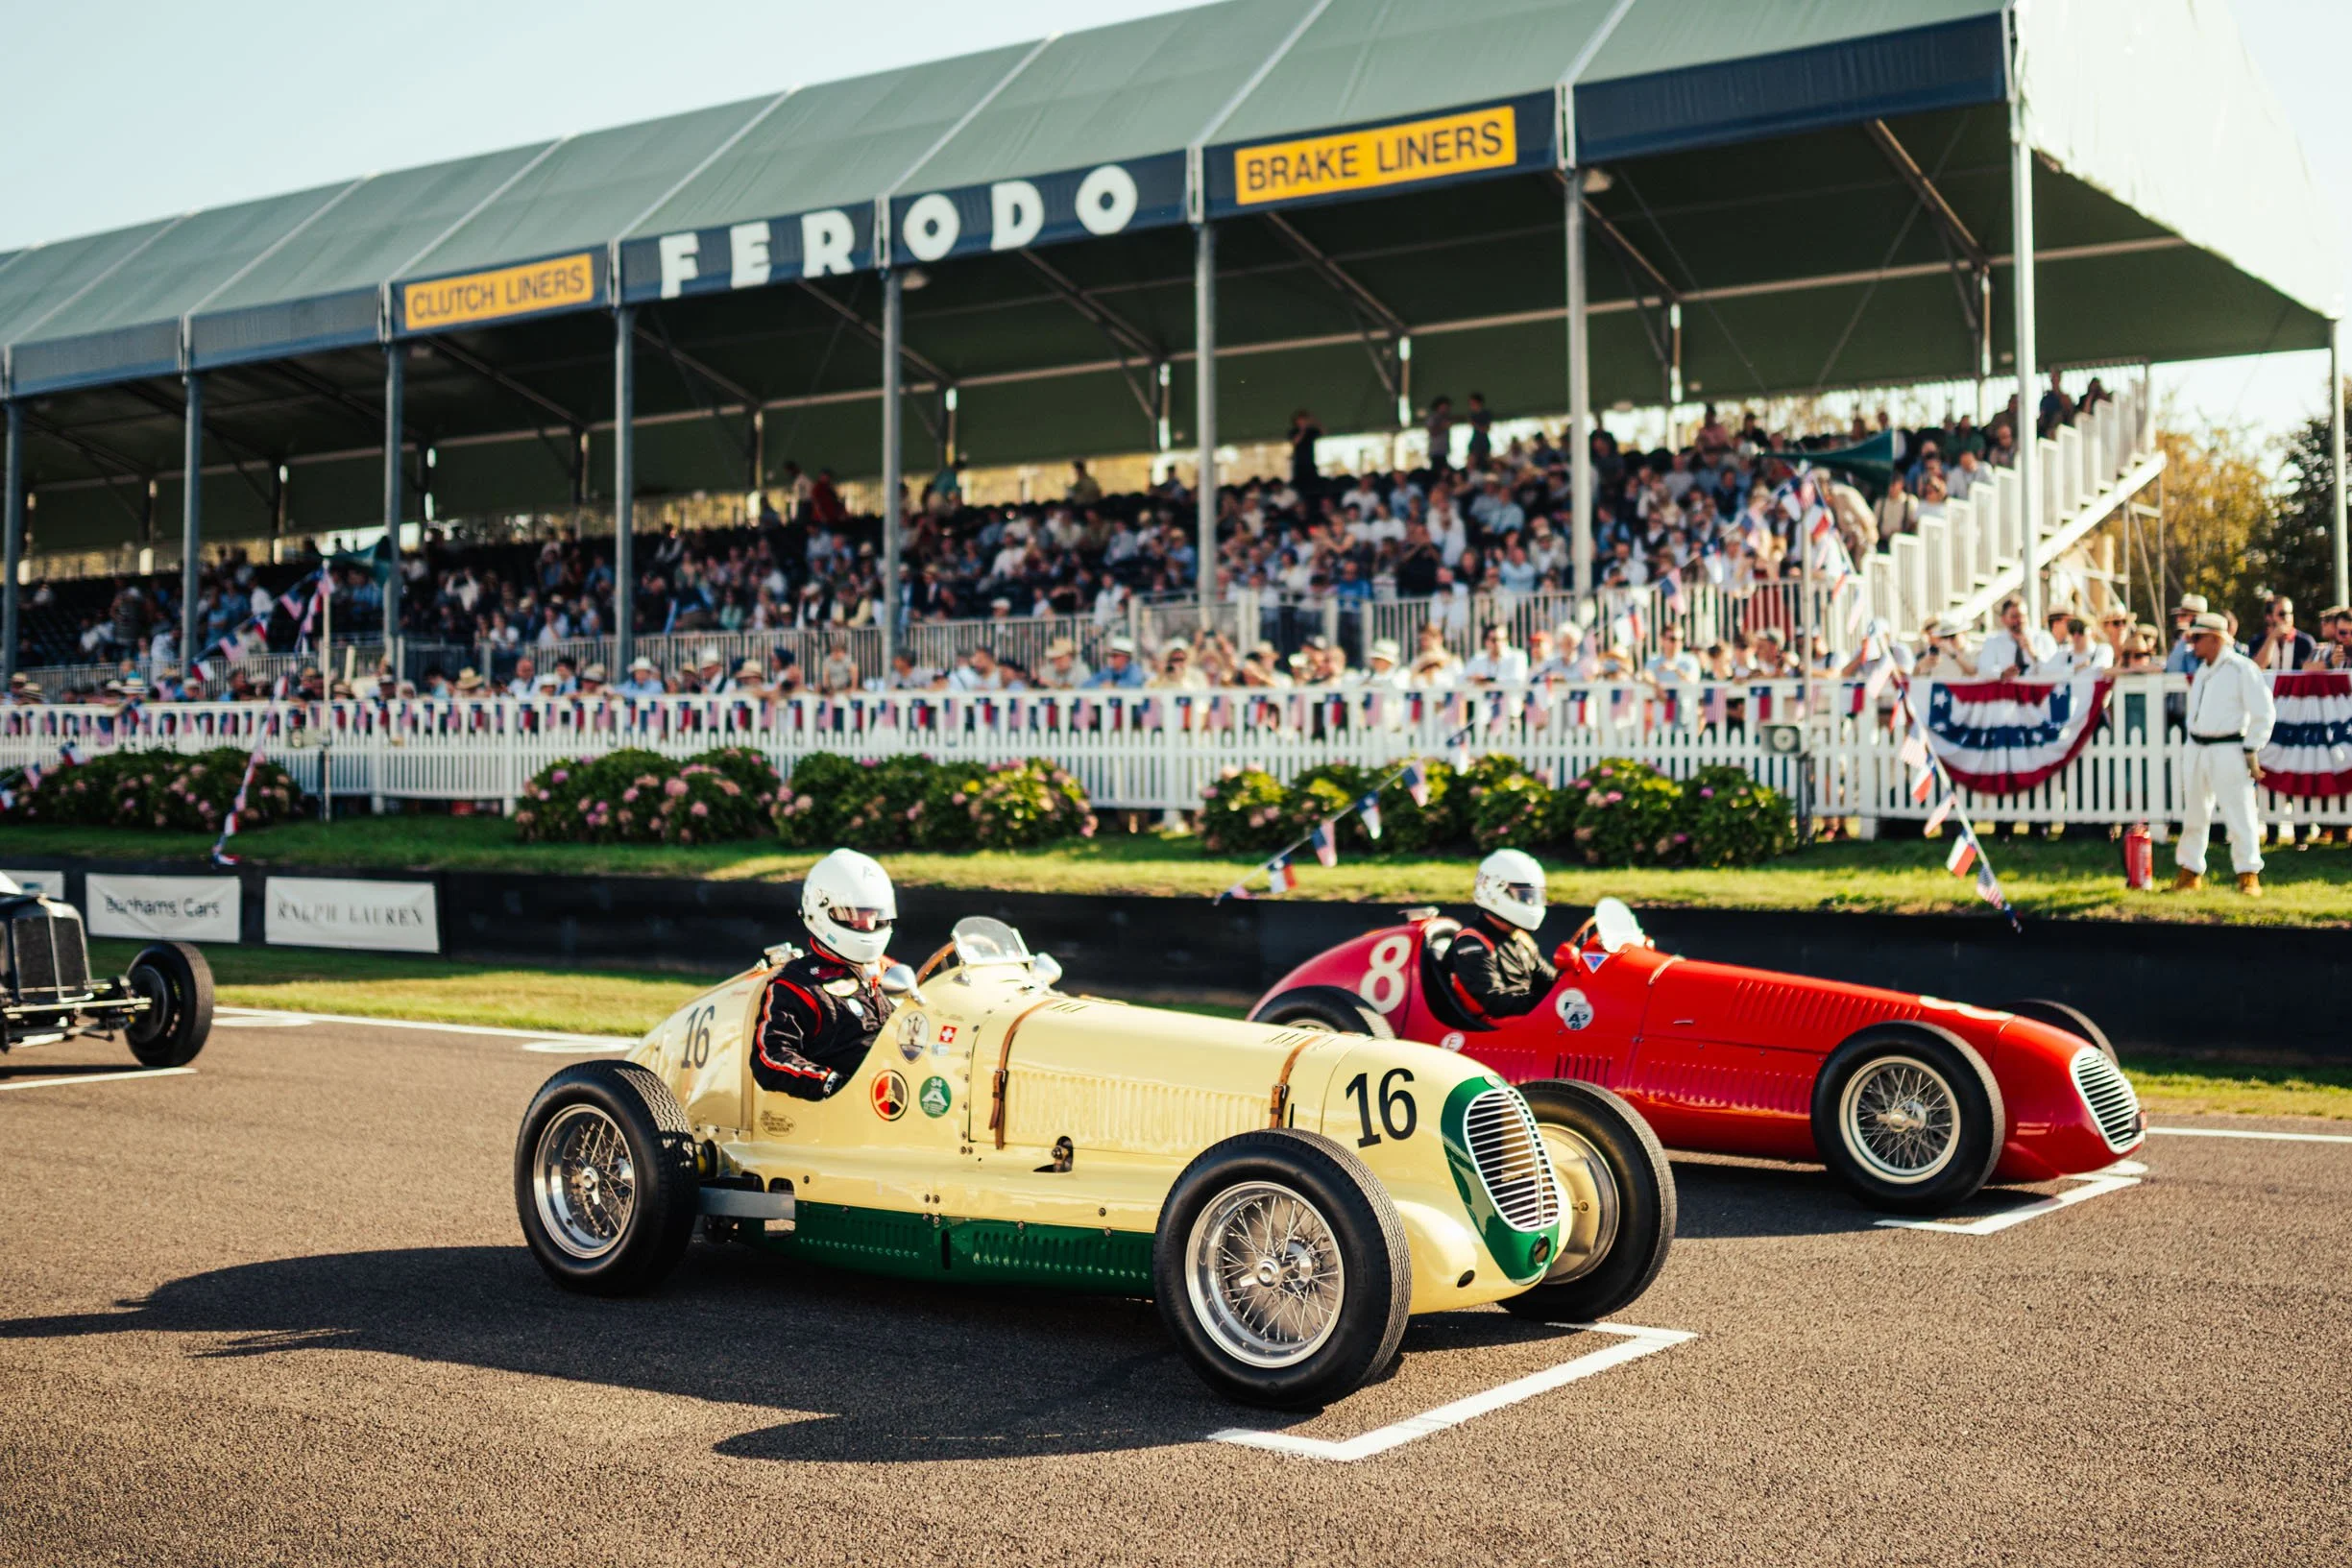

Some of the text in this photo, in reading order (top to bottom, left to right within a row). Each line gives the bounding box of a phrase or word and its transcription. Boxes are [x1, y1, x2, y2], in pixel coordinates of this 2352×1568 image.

[1247, 120, 1503, 192] BRAKE LINERS
[659, 164, 1139, 300] FERODO
[412, 264, 585, 319] CLUTCH LINERS
[183, 897, 220, 918] Cars
[277, 900, 424, 927] RALPH LAUREN
[1359, 934, 1412, 1014] 8
[681, 1004, 715, 1069] 16
[1346, 1067, 1418, 1148] 16
